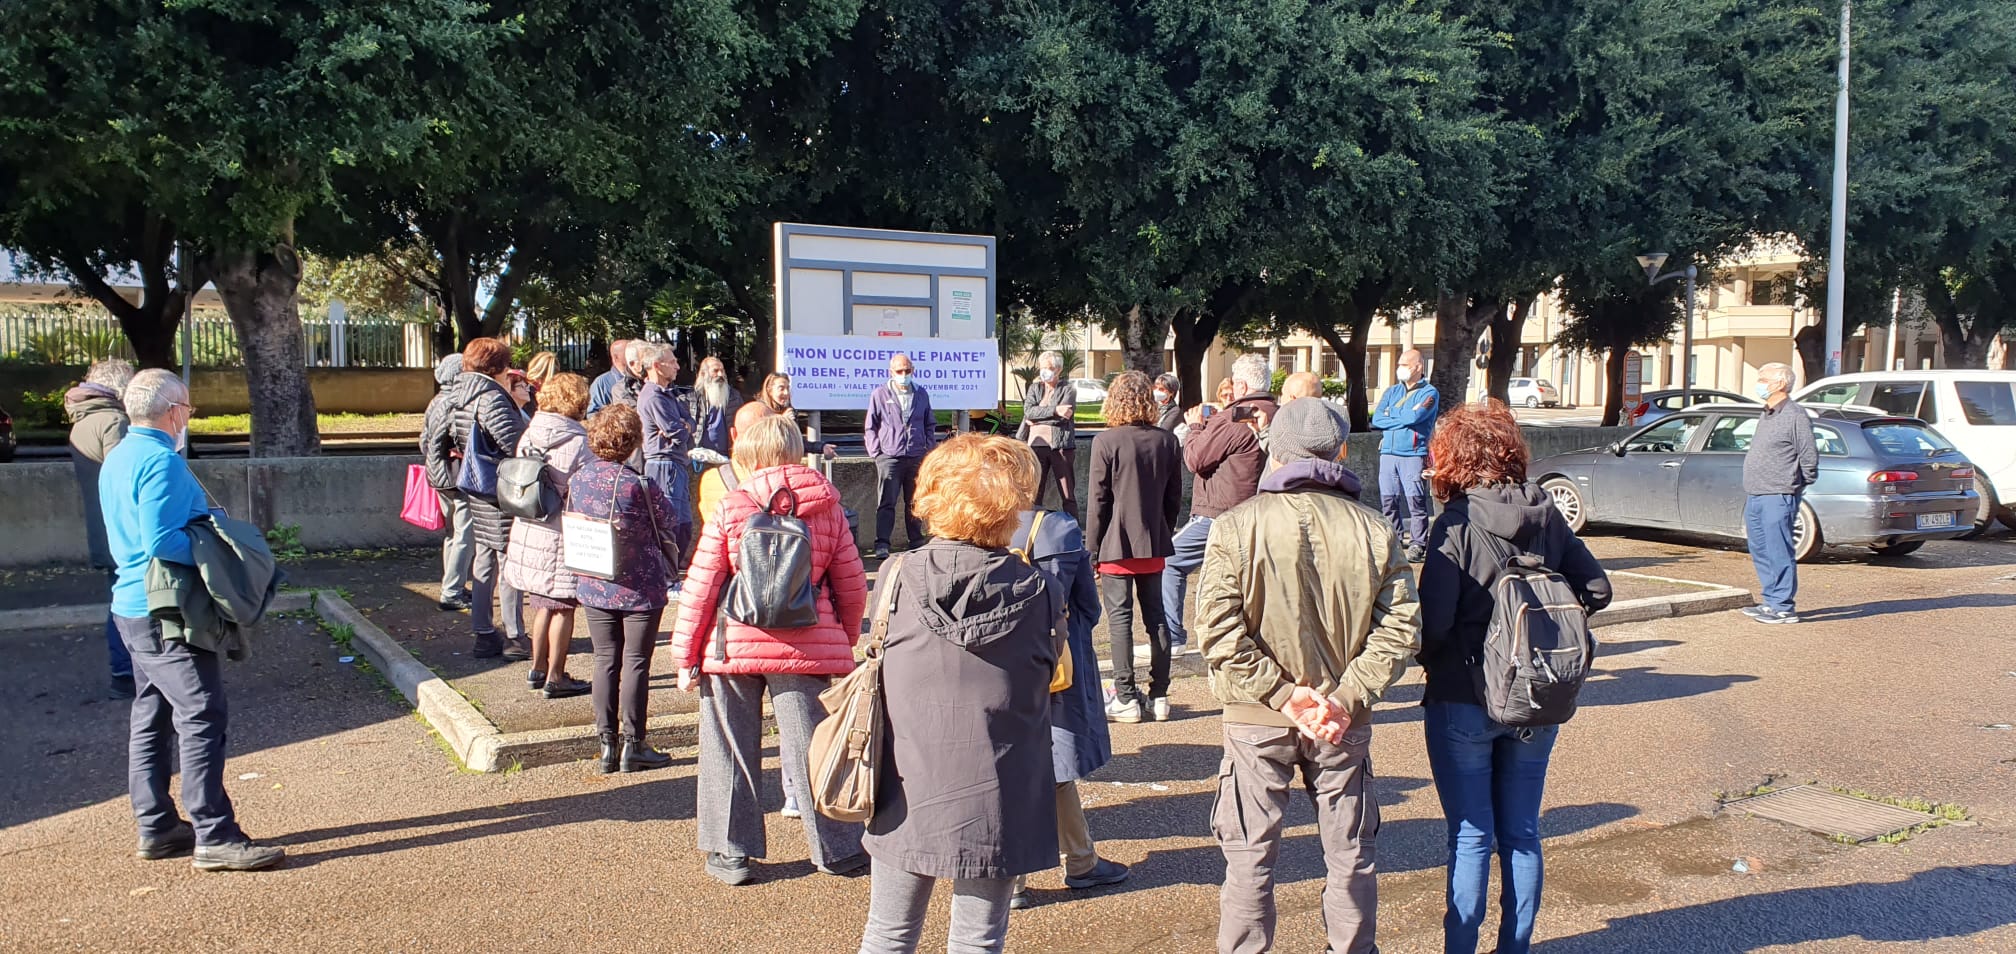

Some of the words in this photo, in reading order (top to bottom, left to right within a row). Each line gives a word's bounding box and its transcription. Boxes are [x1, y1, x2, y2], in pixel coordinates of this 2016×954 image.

[832, 348, 904, 361] UCCIDET
[910, 351, 926, 362] LE
[787, 367, 806, 377] UN
[811, 367, 850, 379] BENE,
[854, 368, 931, 379] PATRINIO
[935, 369, 947, 379] DI
[951, 369, 986, 379] TUTTI
[797, 382, 836, 390] CAGLIARI
